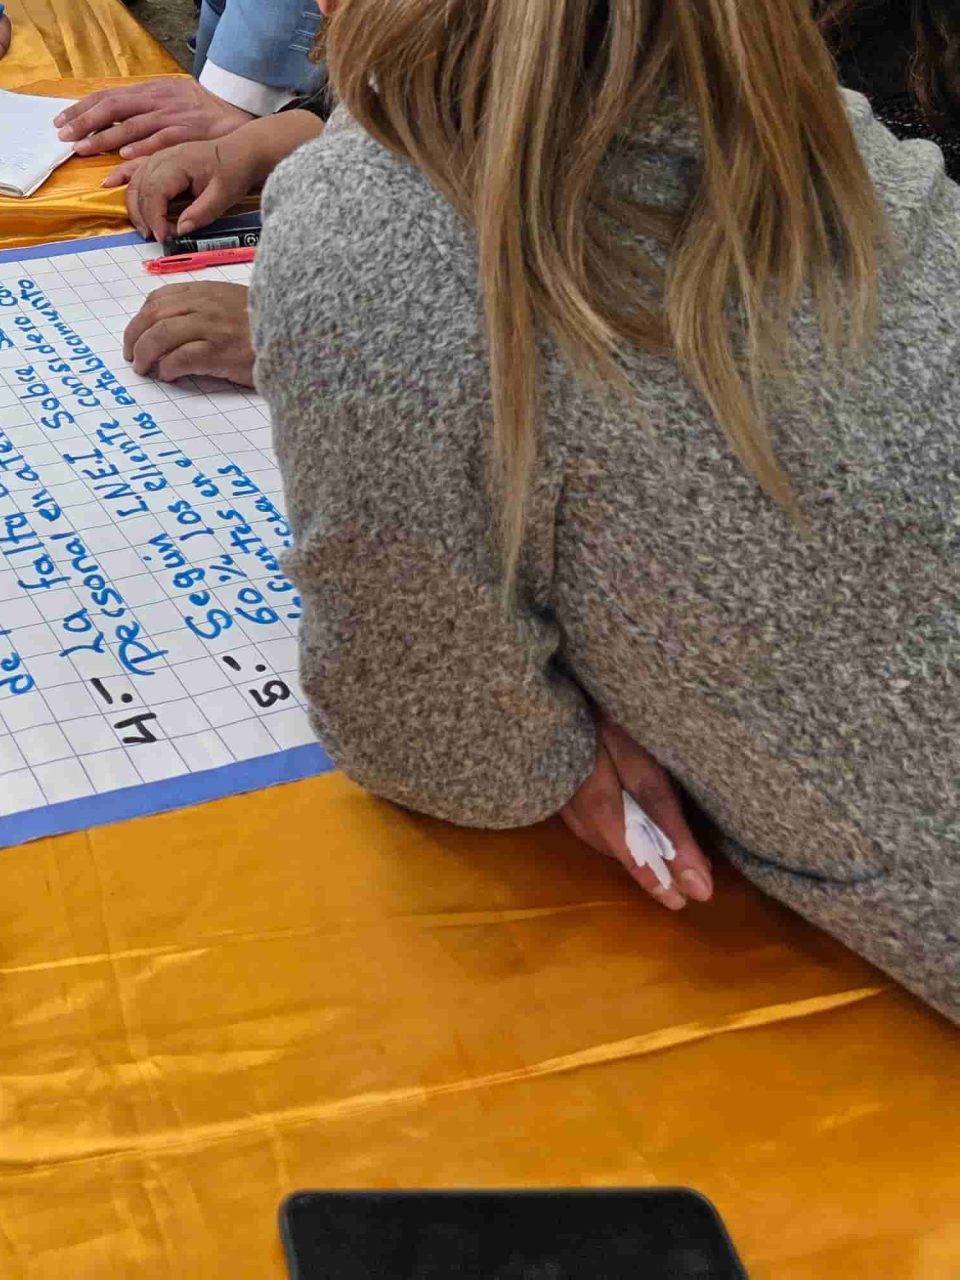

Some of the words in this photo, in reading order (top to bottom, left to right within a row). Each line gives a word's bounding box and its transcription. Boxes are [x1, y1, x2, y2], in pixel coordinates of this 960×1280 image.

[14, 316, 101, 407] considero
[192, 472, 219, 498] en
[31, 488, 61, 522] en
